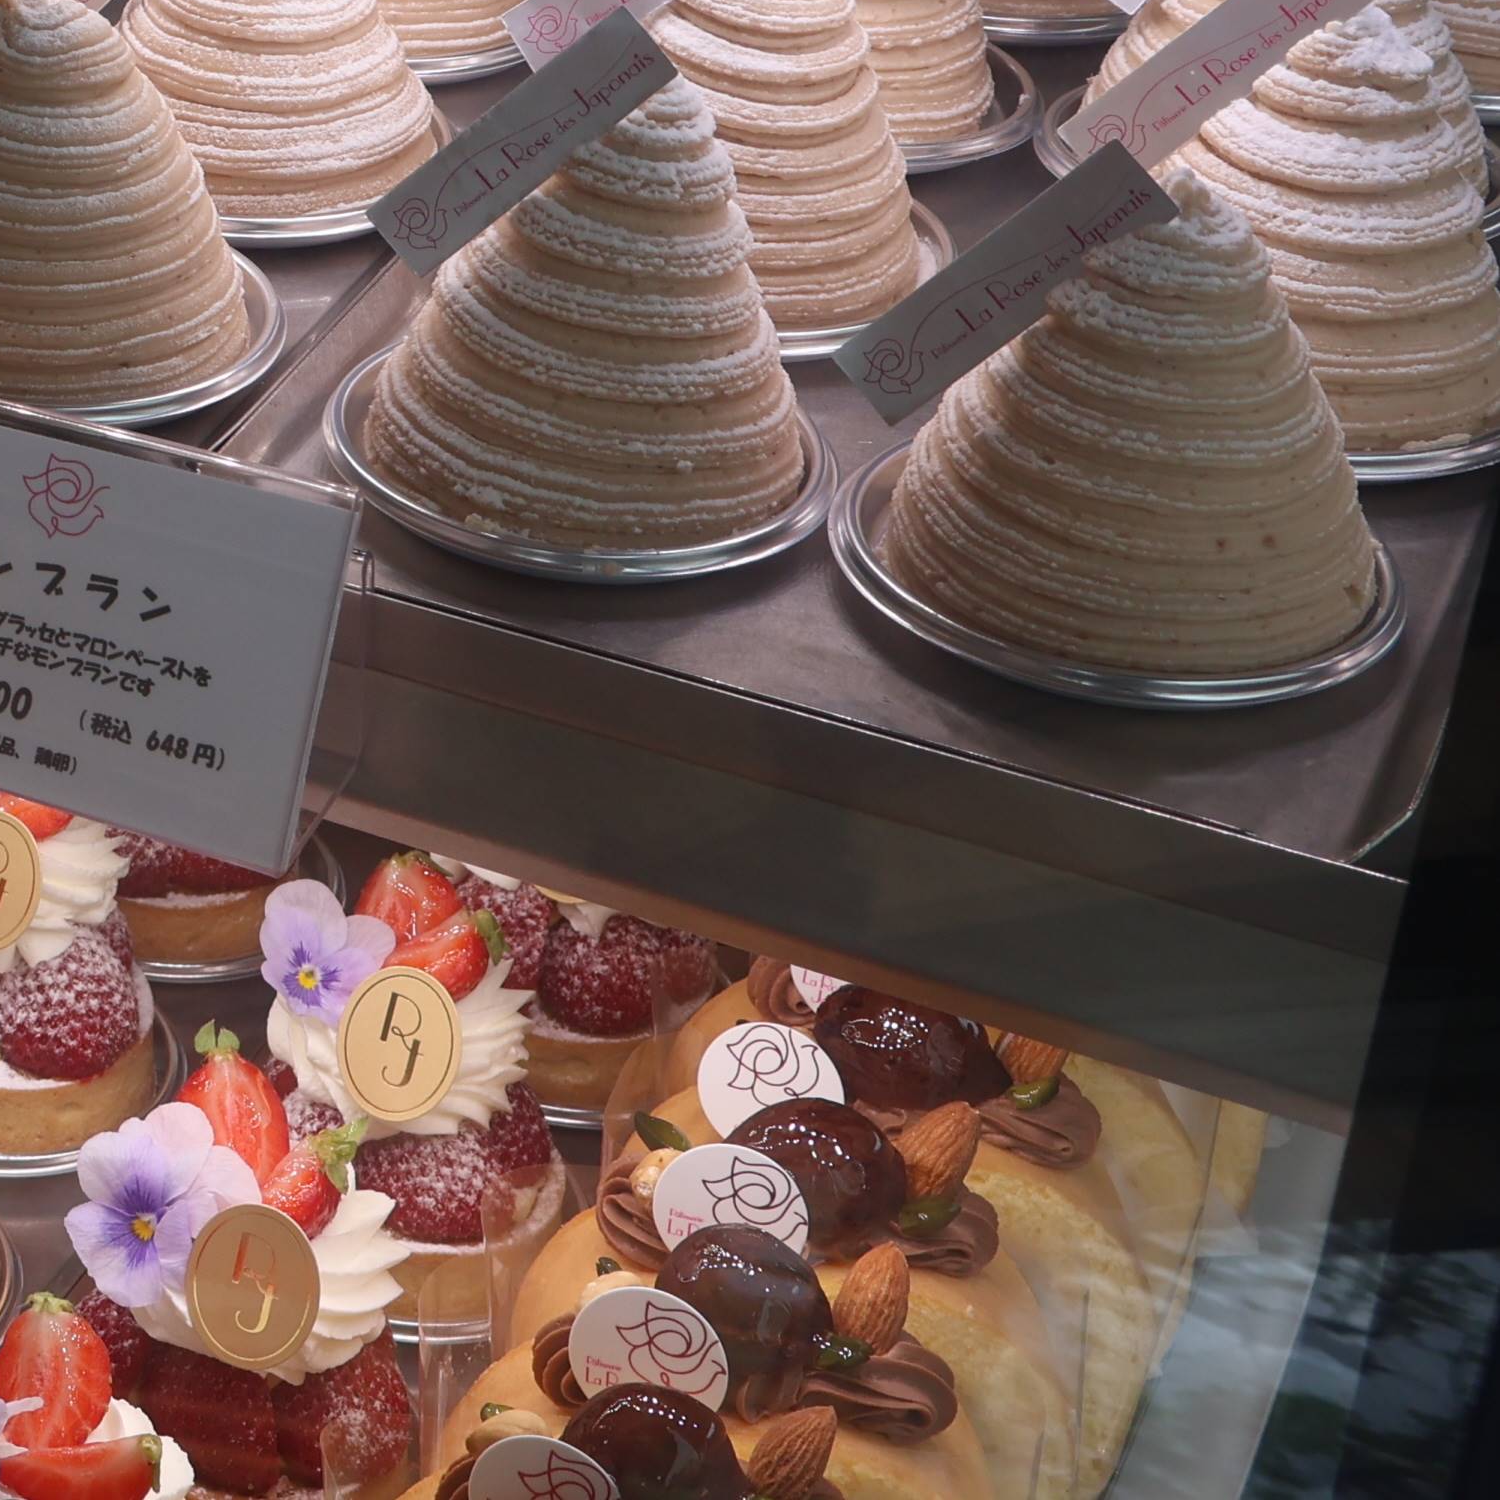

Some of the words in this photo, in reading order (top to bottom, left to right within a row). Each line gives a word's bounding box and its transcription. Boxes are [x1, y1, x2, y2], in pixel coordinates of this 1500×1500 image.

[472, 166, 511, 197] La
[498, 129, 554, 172] Rose
[572, 52, 657, 120] Japonais
[1173, 78, 1212, 108] La
[1200, 43, 1258, 87] Rose
[954, 302, 995, 333] La
[983, 265, 1044, 311] Rose
[1064, 187, 1153, 257] Japonais
[79, 709, 132, 745] (税込
[145, 731, 226, 782] 648円)
